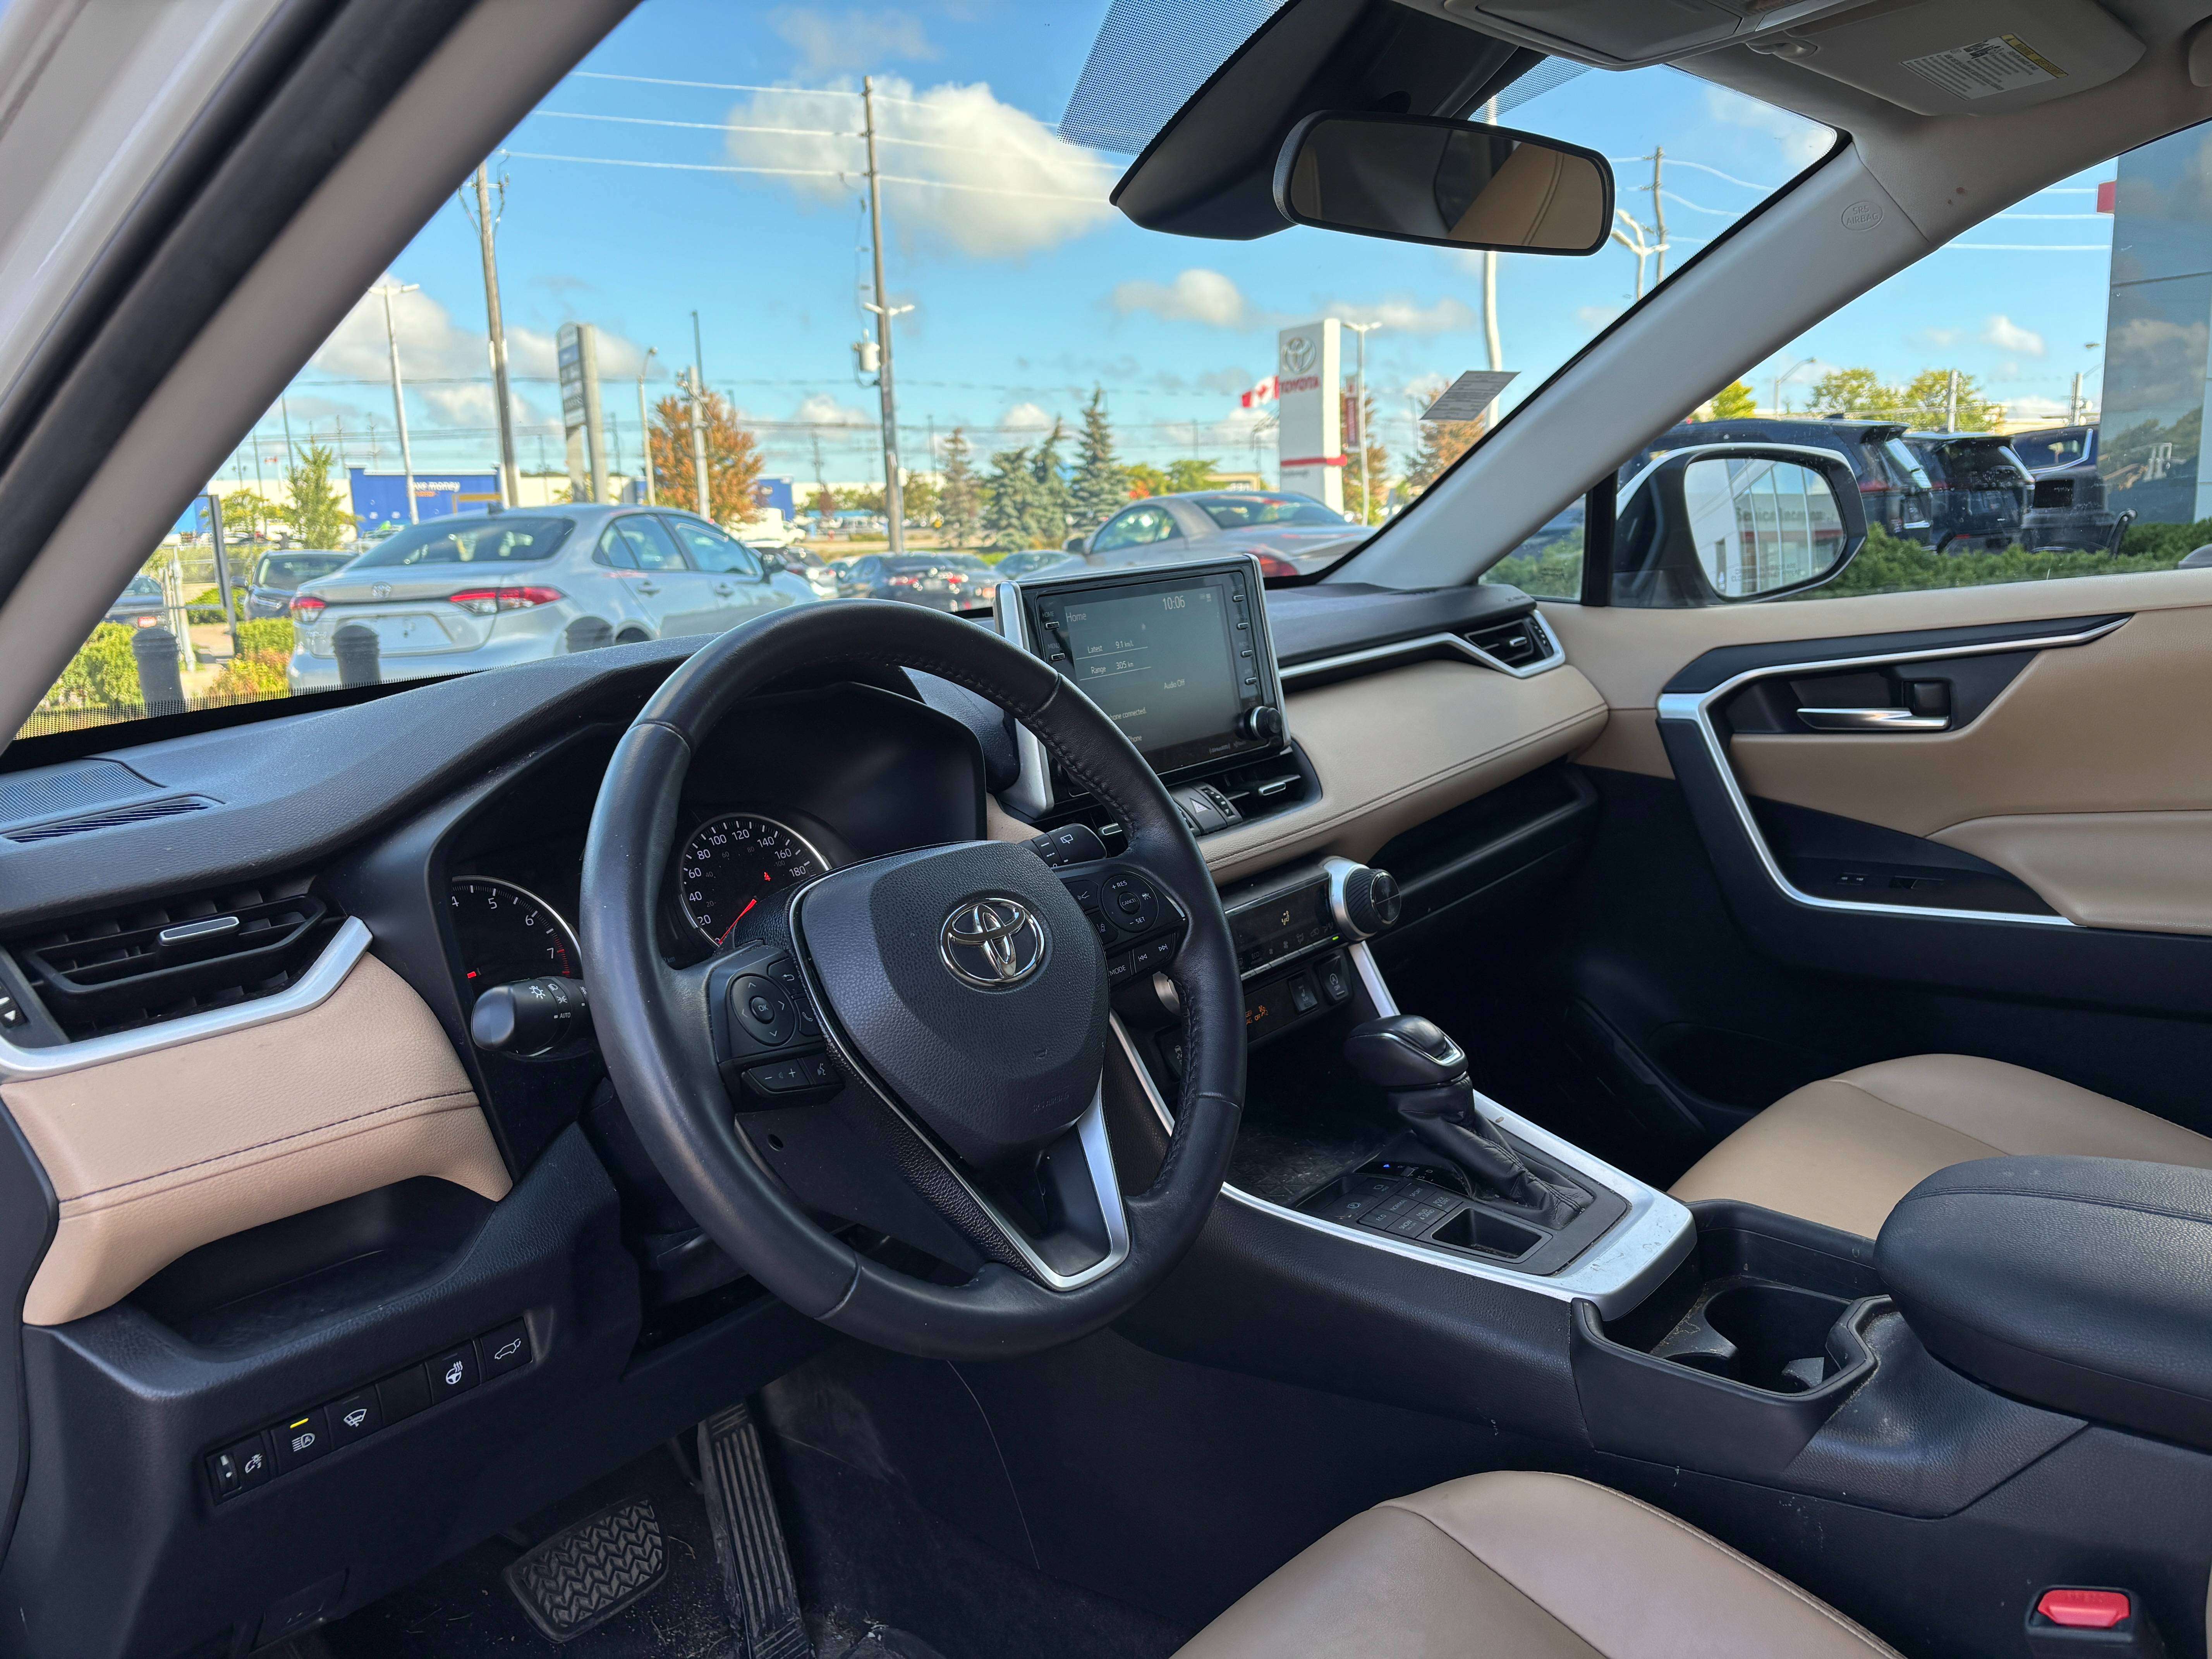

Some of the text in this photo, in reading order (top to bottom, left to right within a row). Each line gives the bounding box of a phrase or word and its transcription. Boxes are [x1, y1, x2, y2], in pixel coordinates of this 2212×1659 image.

[1853, 205, 1870, 215] SRS
[1846, 213, 1879, 225] AIRBAG
[1279, 376, 1320, 394] TOYOTA
[428, 481, 460, 492] money
[1163, 595, 1185, 610] 10:06
[1066, 612, 1086, 622] Home
[1087, 645, 1103, 653] Latest
[1116, 661, 1127, 670] 305
[709, 834, 727, 846] 100
[732, 829, 749, 840] 120
[757, 836, 775, 848] 140
[697, 849, 711, 860] 80
[775, 848, 792, 859] 160
[689, 867, 701, 878] 60
[789, 866, 806, 877] 180
[452, 896, 459, 907] 4
[689, 891, 702, 902] 40
[488, 898, 498, 909] 5
[526, 915, 534, 926] 6
[697, 915, 711, 925] 20
[547, 948, 555, 959] 7
[1109, 965, 1126, 976] MODE
[1410, 1188, 1423, 1197] SPORT
[1390, 1200, 1408, 1211] NORMAL
